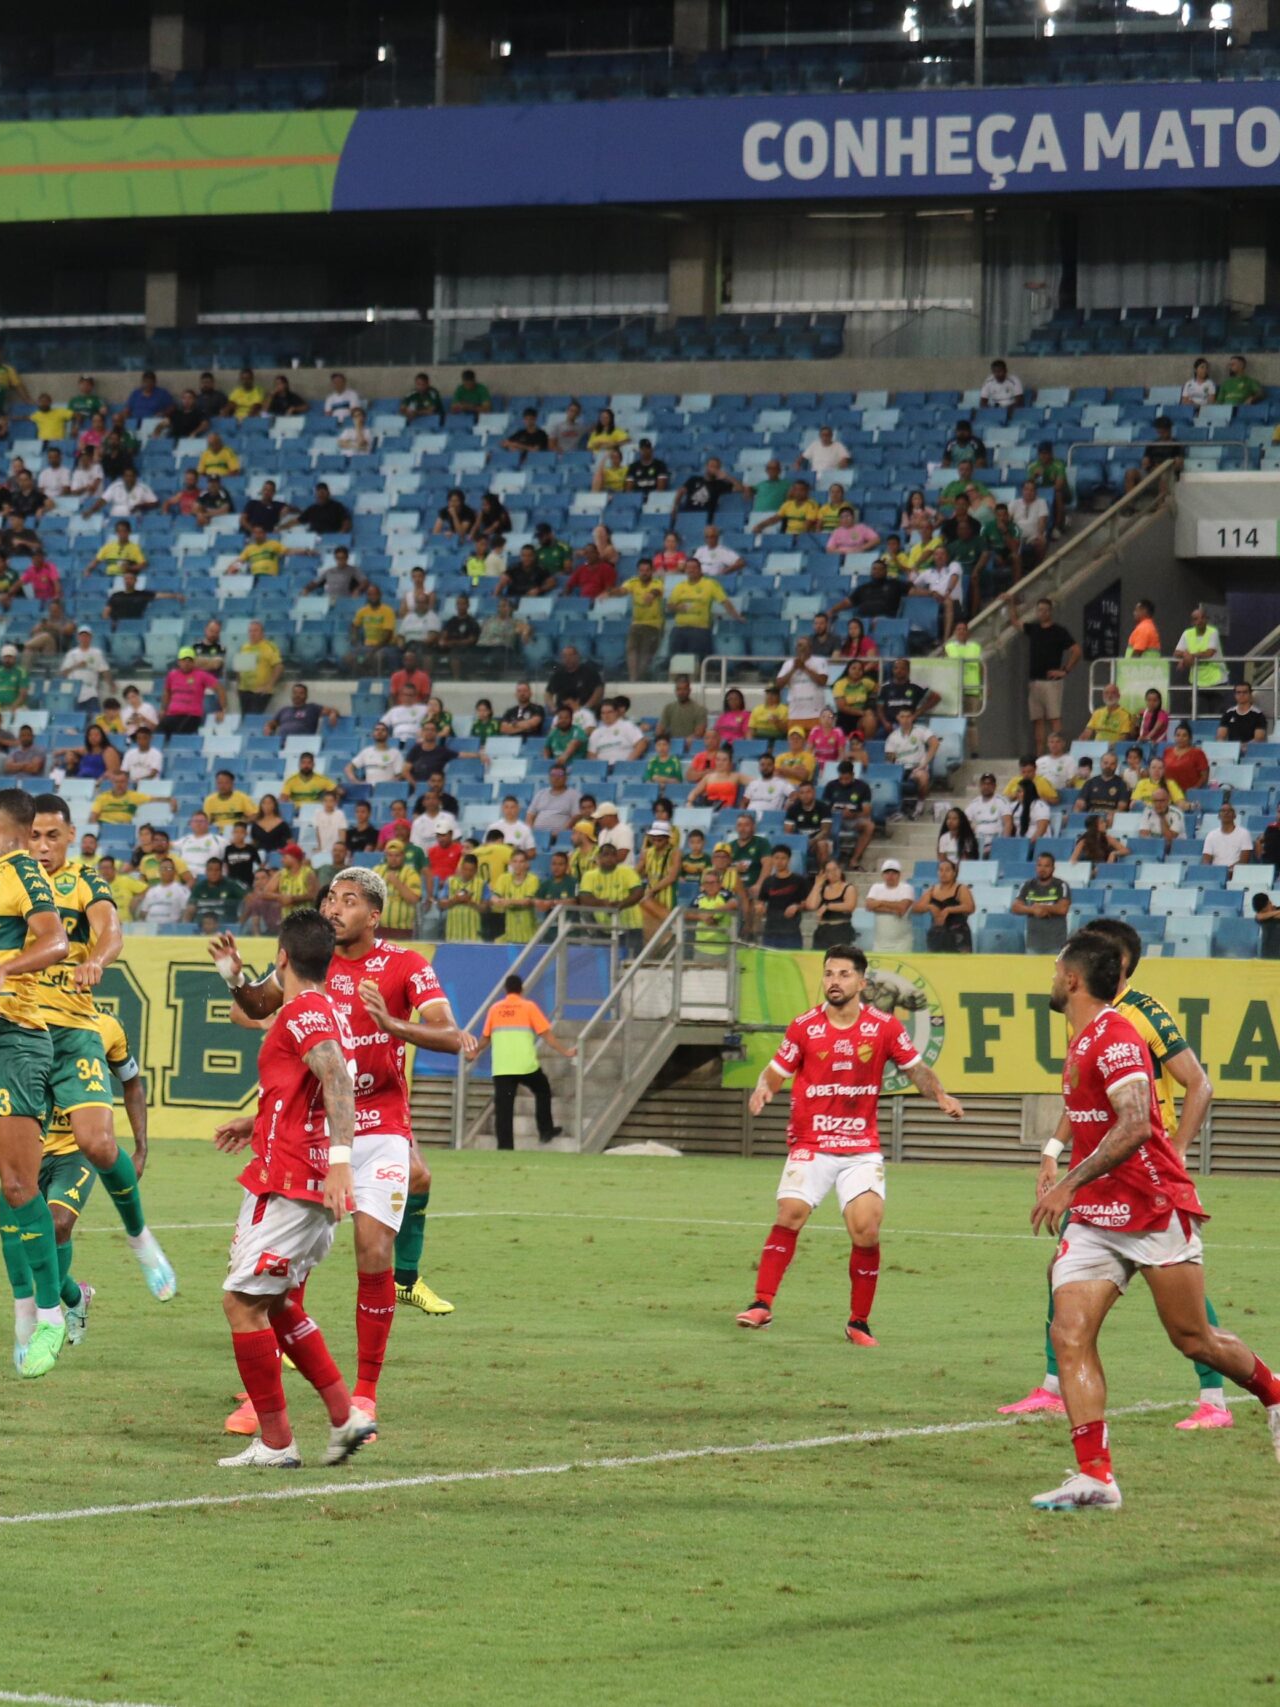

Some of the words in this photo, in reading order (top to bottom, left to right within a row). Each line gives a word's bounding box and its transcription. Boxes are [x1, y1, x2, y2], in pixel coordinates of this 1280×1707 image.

[742, 113, 1067, 190] CONHEÇA
[1083, 106, 1280, 171] MATO
[1217, 528, 1259, 548] 114
[76, 1057, 105, 1081] 34
[812, 1114, 867, 1131] Rizzo
[75, 1166, 90, 1188] 7
